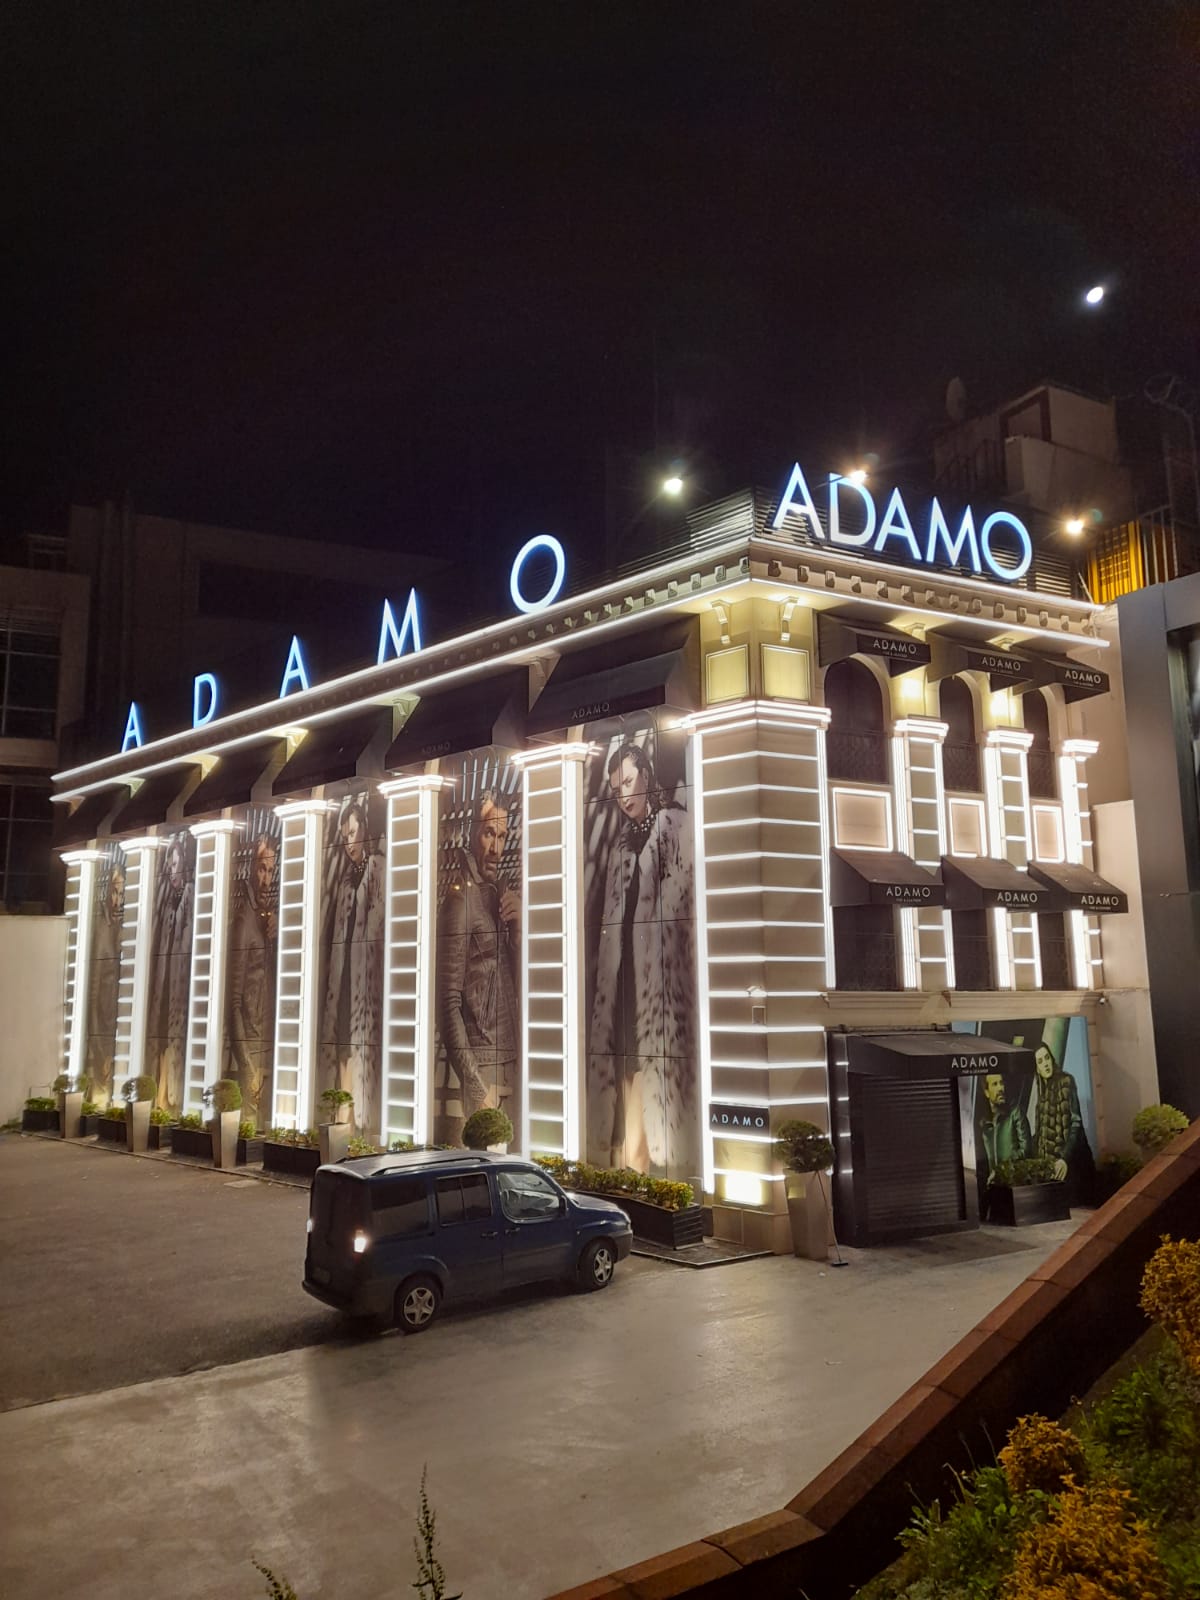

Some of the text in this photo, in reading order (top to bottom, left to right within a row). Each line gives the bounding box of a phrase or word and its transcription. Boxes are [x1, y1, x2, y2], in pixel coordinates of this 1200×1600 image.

[772, 461, 1032, 580] ADAMO
[873, 639, 917, 654] ADAMO
[981, 656, 1021, 671] ADAMO
[1064, 670, 1101, 684] ADAMO
[886, 886, 931, 898] ADAMO
[997, 891, 1038, 903] ADAMO
[1080, 895, 1119, 906] ADAMO
[951, 1055, 998, 1069] ADAMO
[711, 1113, 764, 1128] ADAMO
